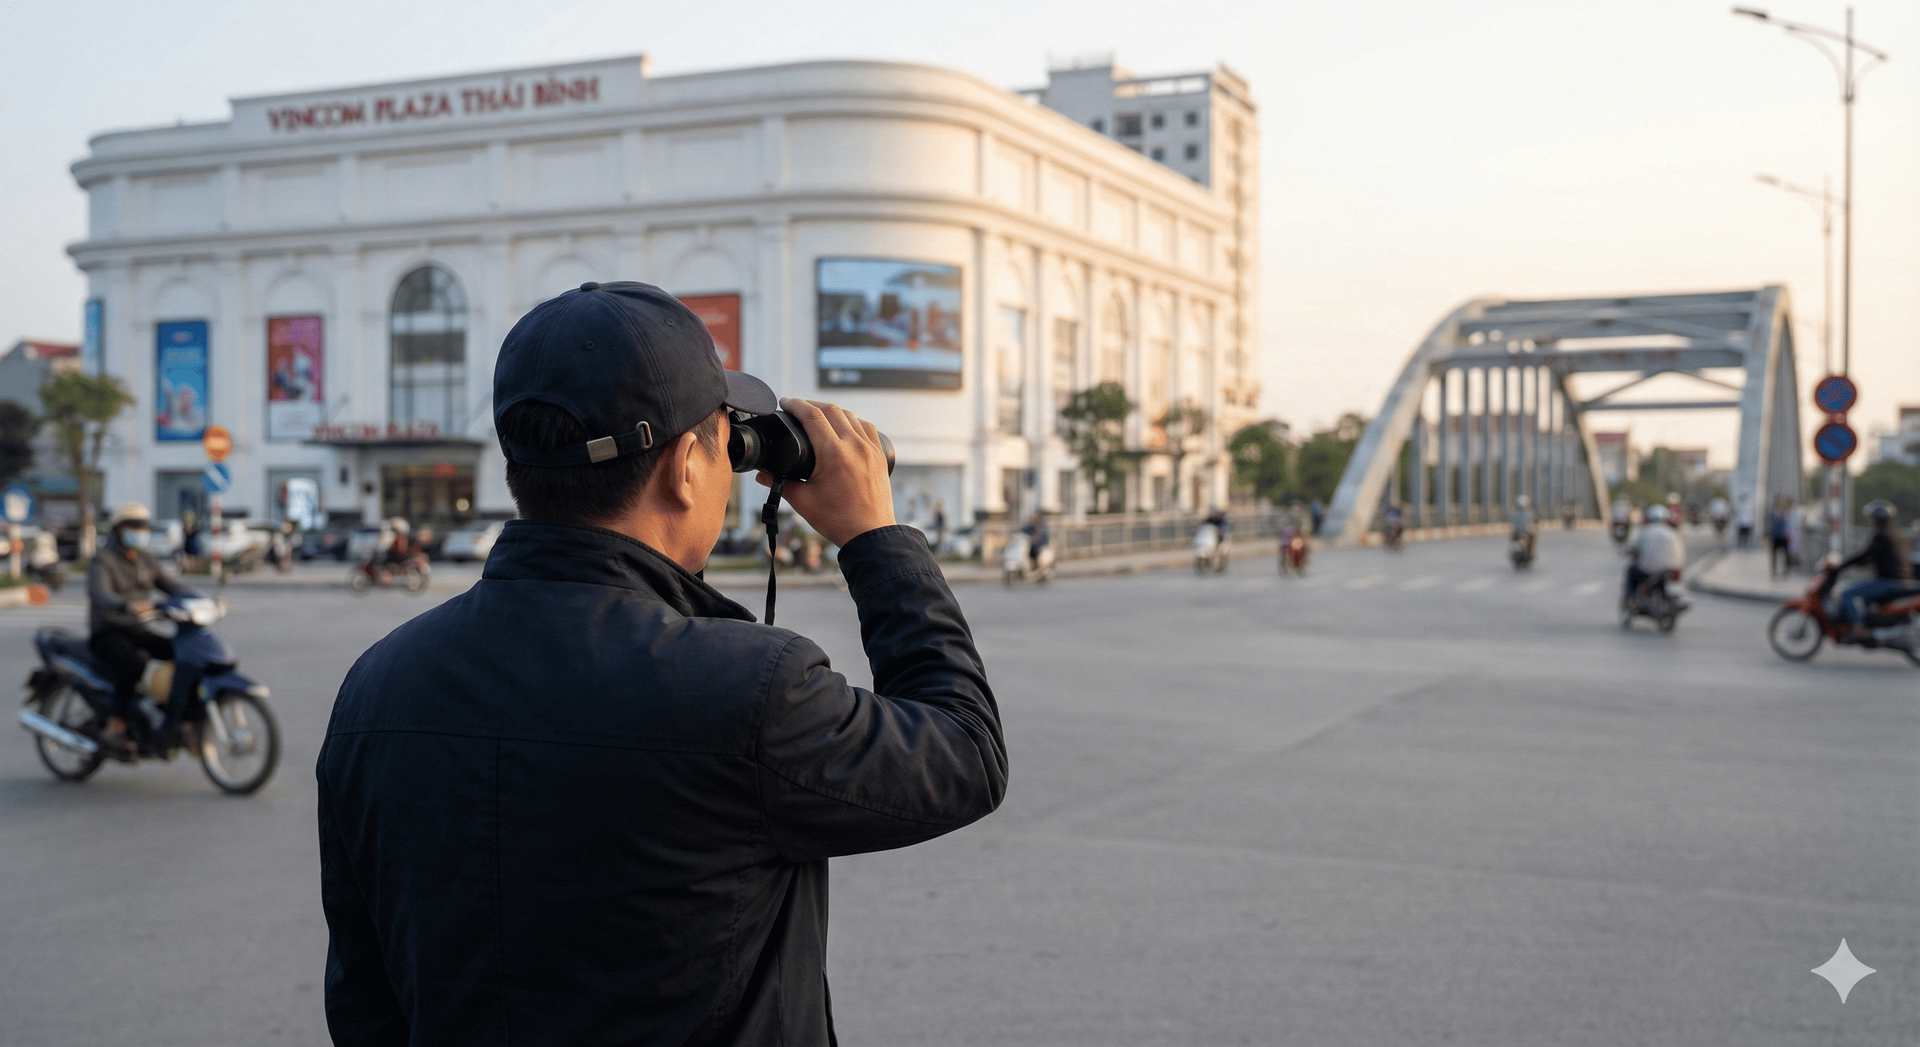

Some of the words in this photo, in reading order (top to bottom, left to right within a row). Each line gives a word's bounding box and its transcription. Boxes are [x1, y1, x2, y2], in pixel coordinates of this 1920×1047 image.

[268, 102, 366, 131] VINCOM
[374, 91, 453, 121] PLAZA
[461, 77, 525, 114] THÁI
